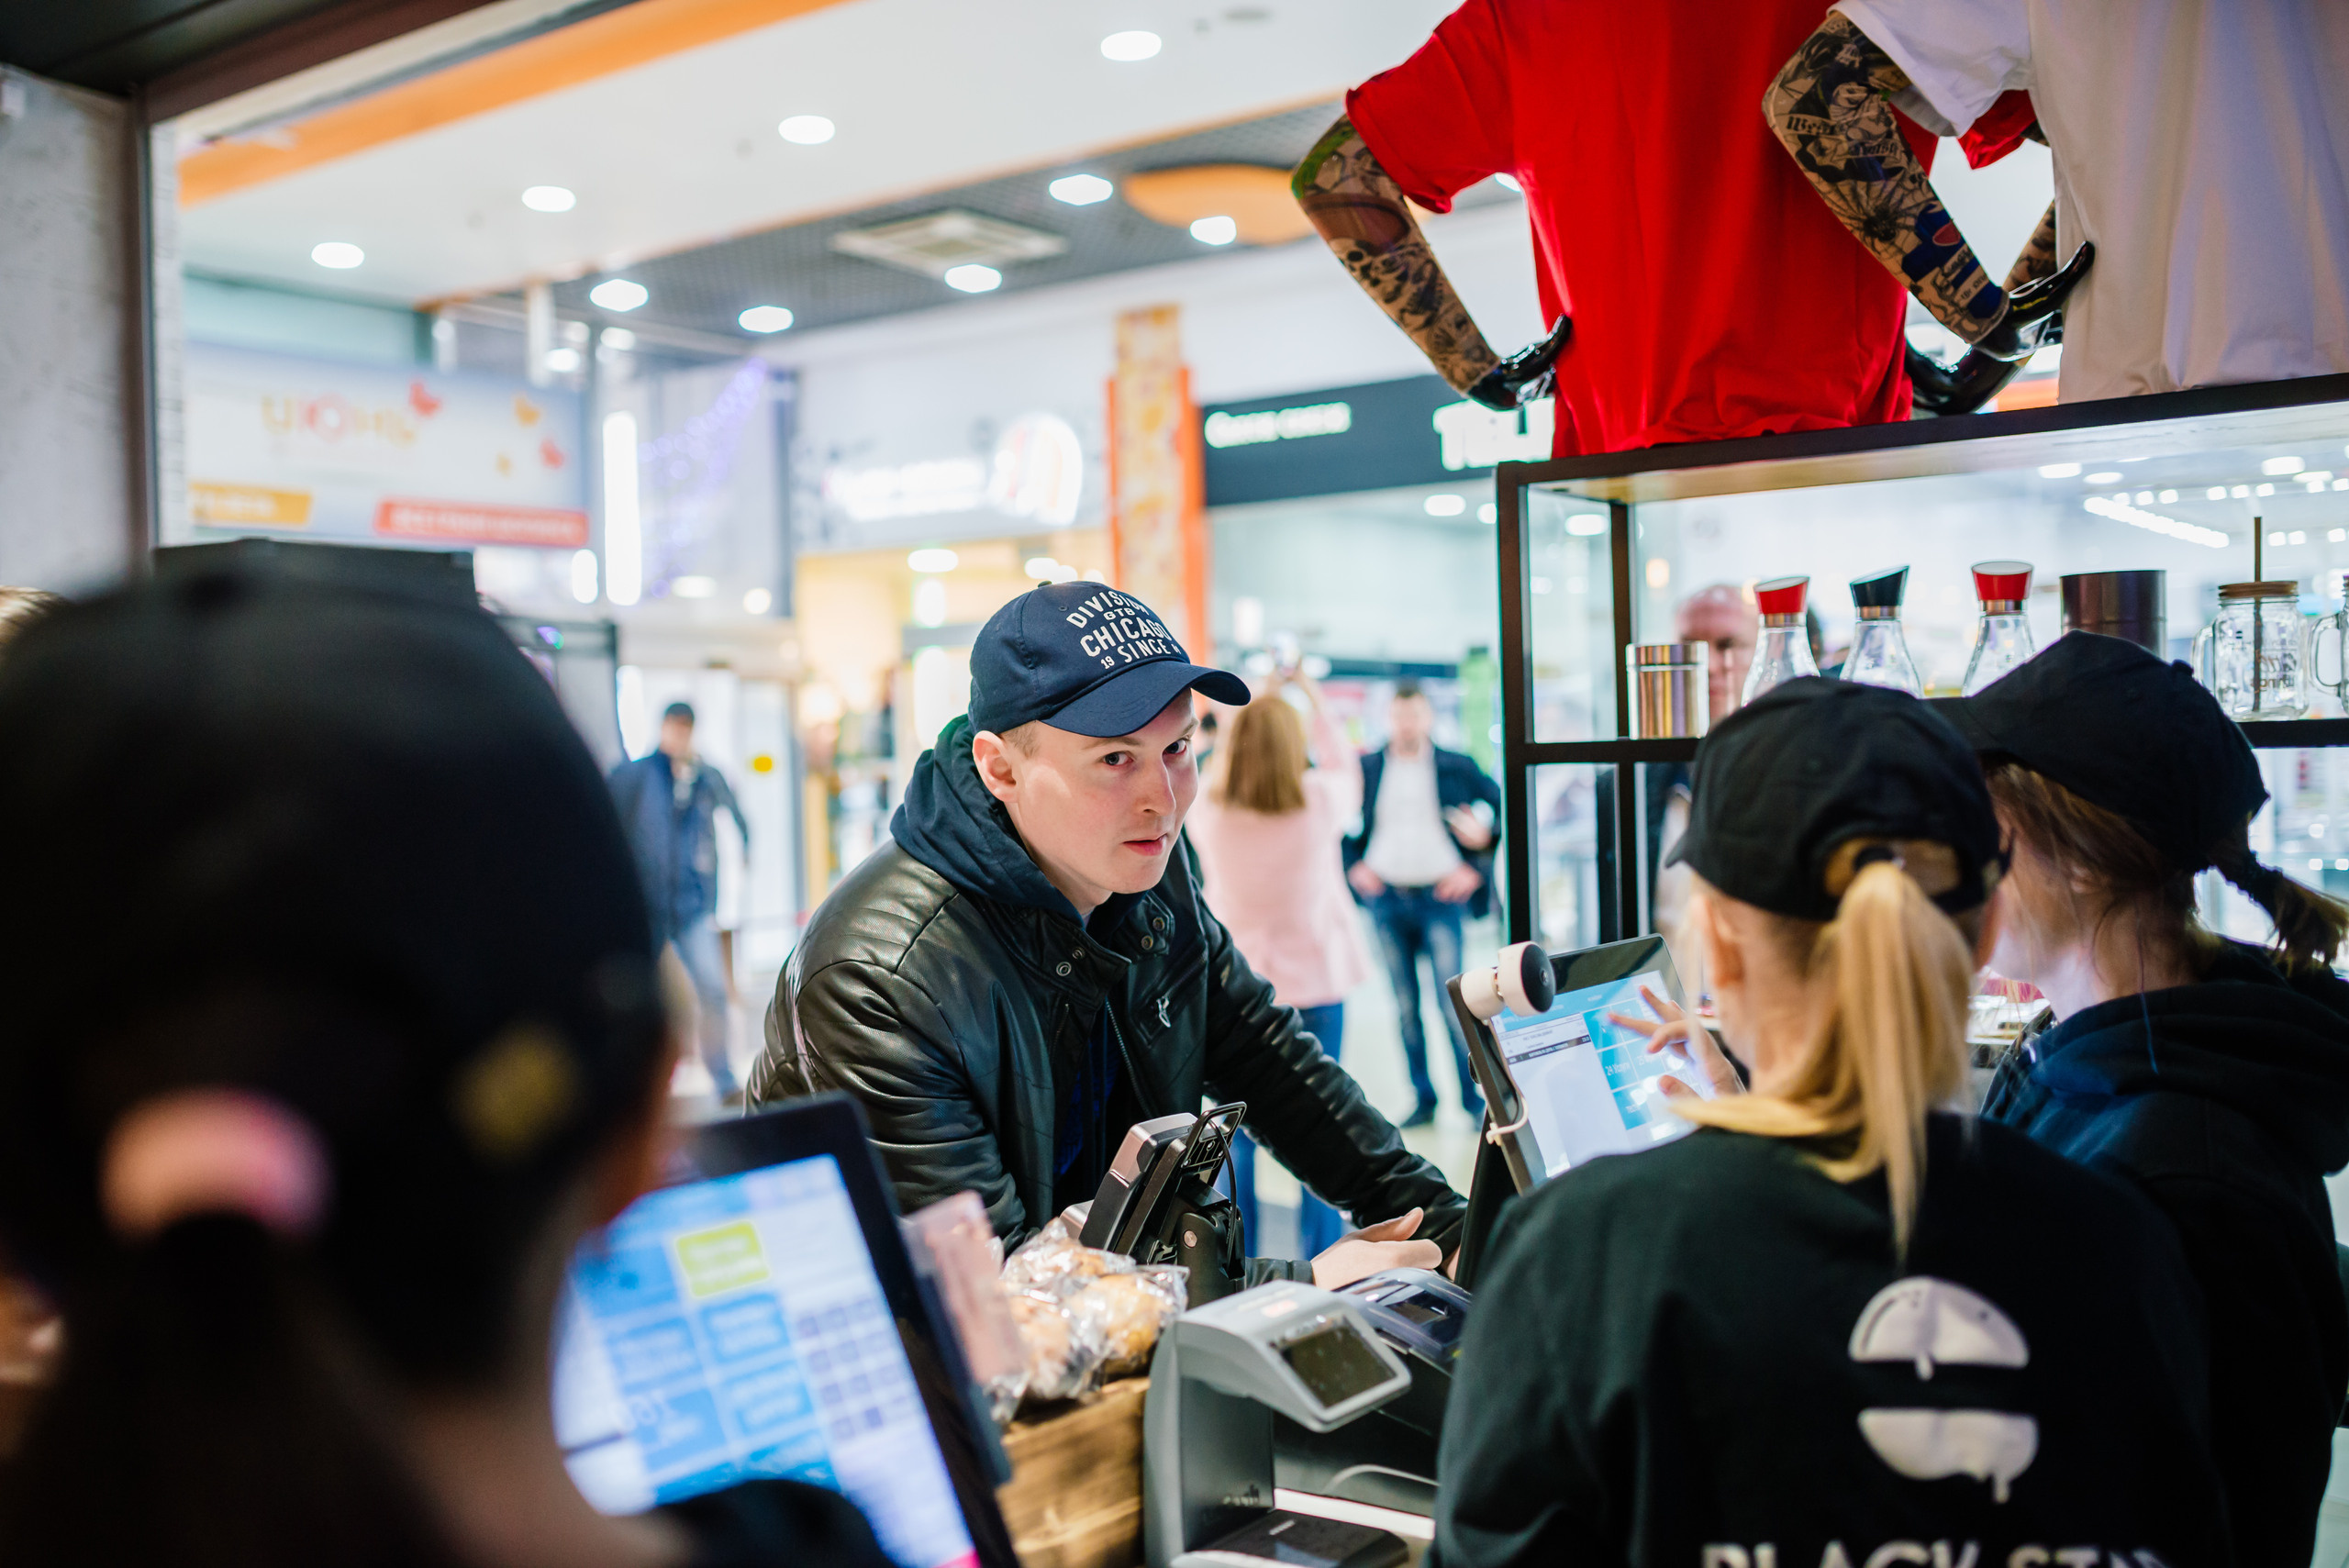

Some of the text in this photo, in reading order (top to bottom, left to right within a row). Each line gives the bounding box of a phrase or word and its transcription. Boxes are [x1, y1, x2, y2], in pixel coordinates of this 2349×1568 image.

[1065, 590, 1150, 628] DIVISION
[1103, 607, 1136, 621] GTB
[1080, 617, 1173, 657] CHICAGO
[1100, 655, 1115, 670] 19
[1117, 639, 1172, 663] SINCE
